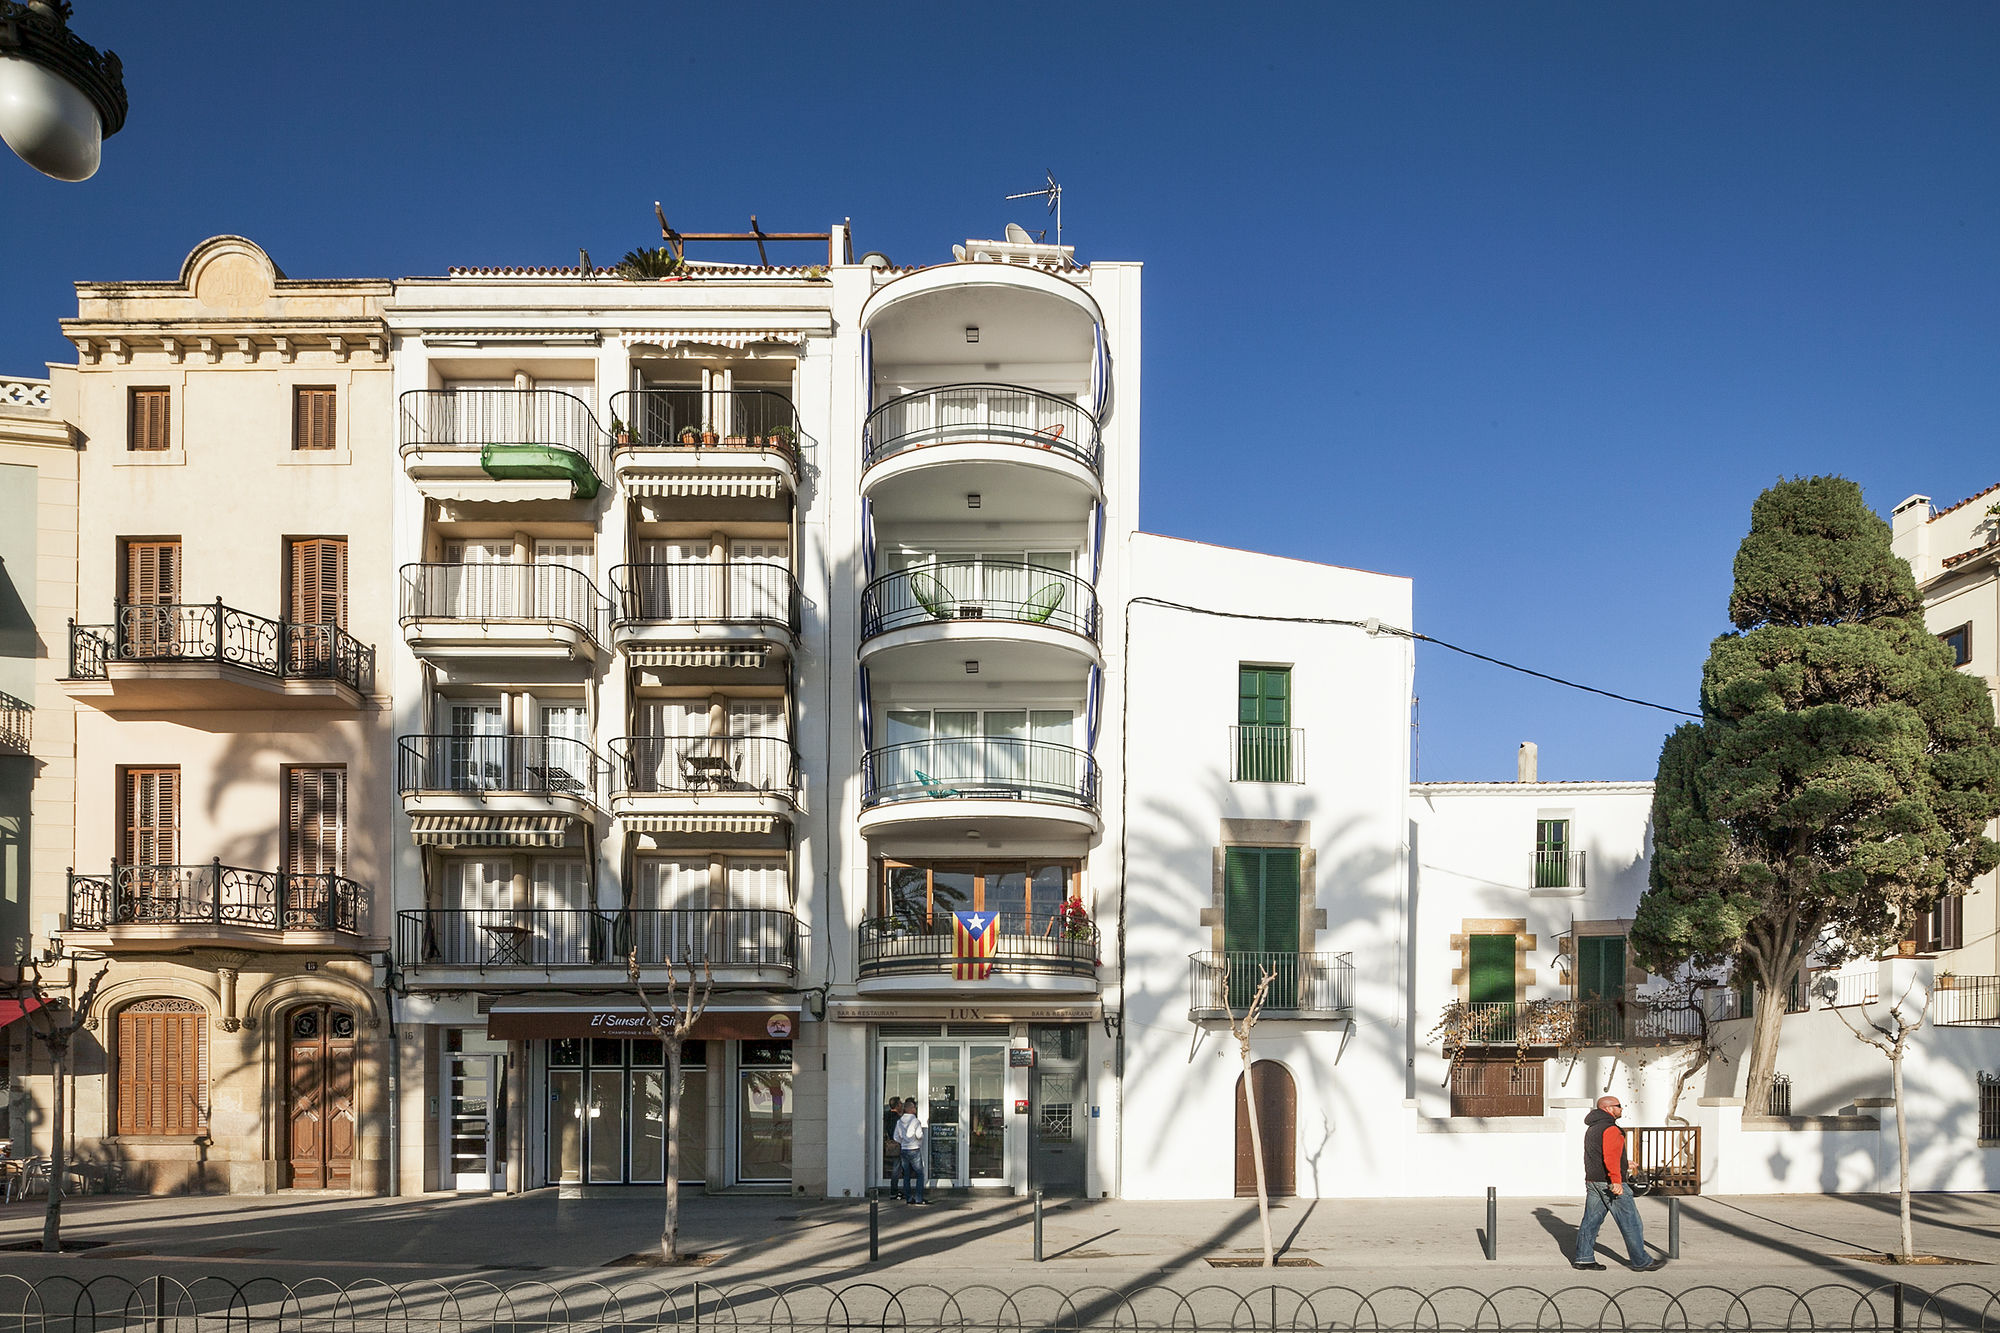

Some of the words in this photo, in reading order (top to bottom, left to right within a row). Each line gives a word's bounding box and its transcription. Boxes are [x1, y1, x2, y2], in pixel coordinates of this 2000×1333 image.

[591, 1014, 606, 1026] El
[605, 1015, 645, 1027] Sunset
[951, 1009, 980, 1020] LUX
